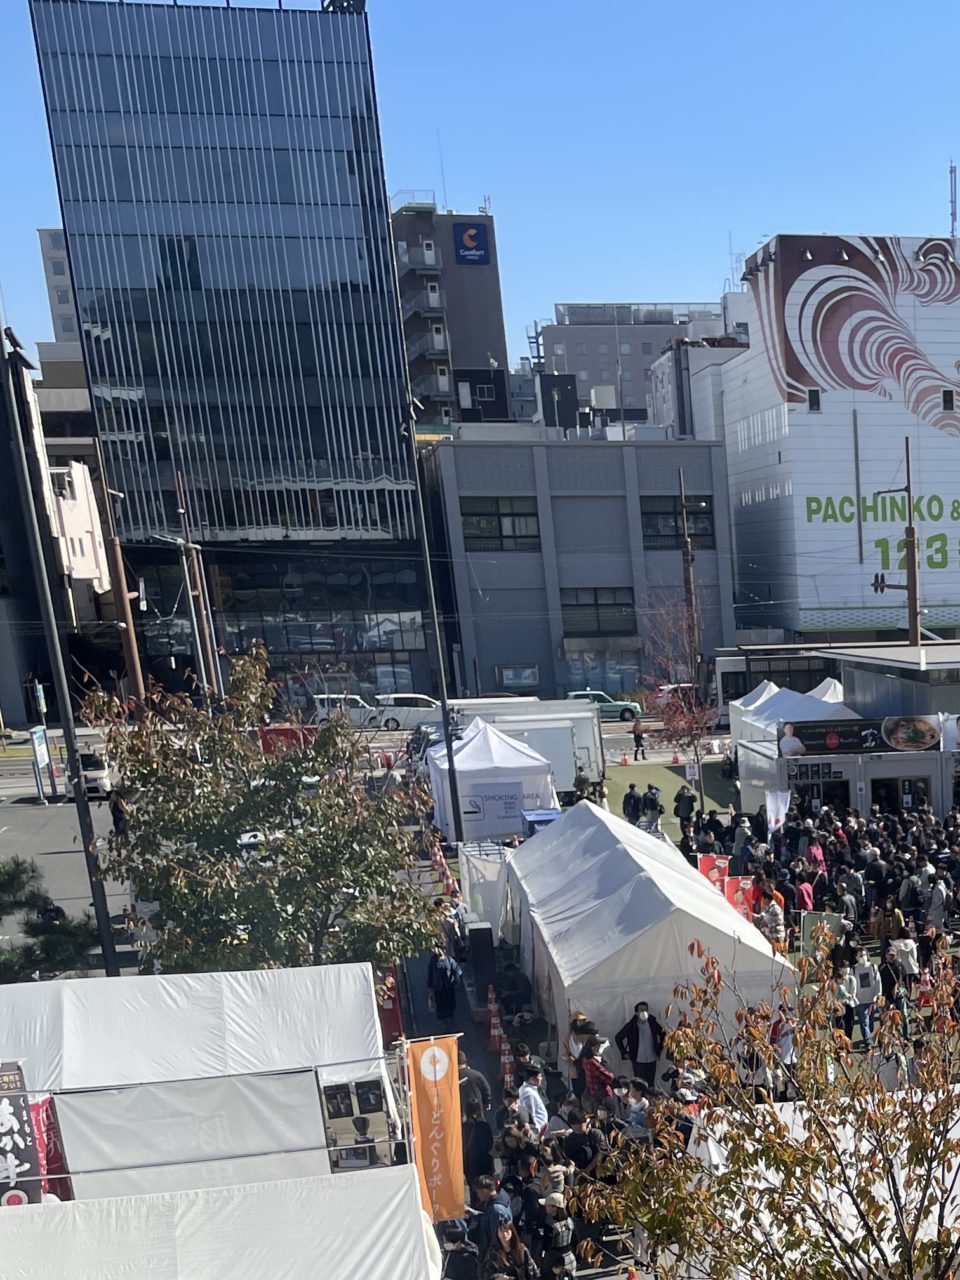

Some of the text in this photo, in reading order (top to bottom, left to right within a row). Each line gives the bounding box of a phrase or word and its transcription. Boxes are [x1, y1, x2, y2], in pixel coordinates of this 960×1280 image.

[805, 494, 944, 523] PACHINKO
[484, 792, 541, 801] SMOKING AREA
[20, 1096, 33, 1146] くまもと
